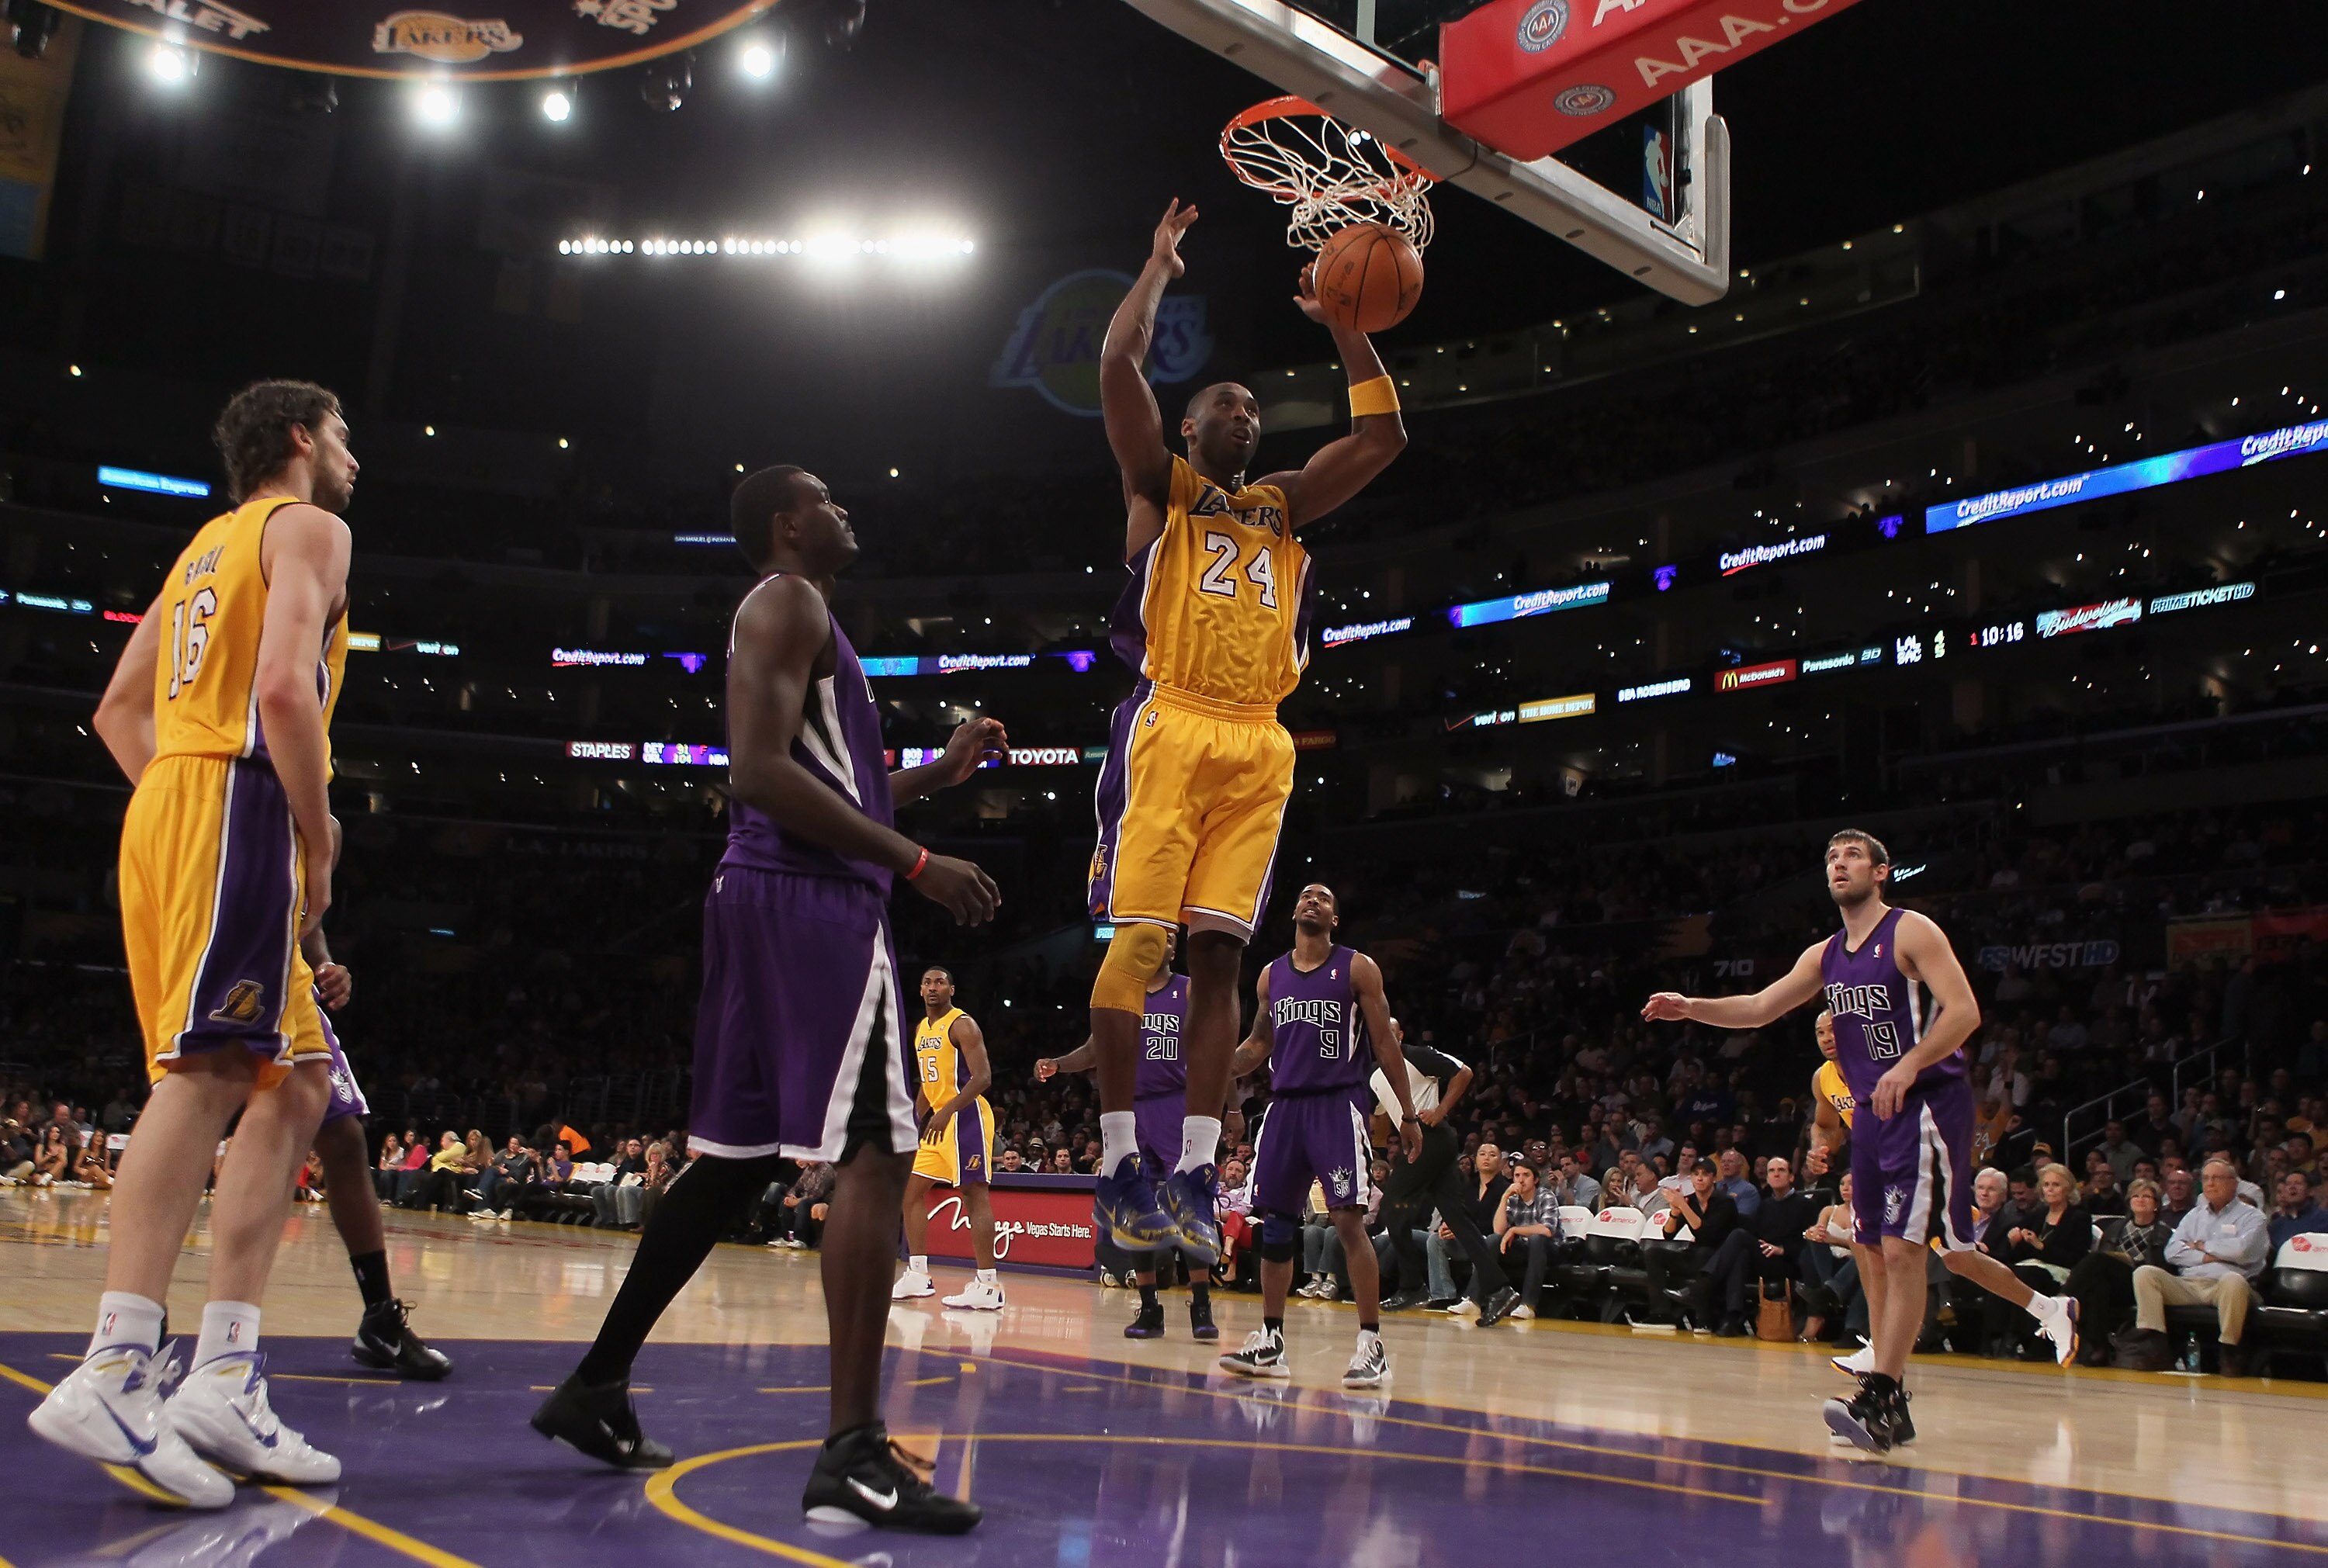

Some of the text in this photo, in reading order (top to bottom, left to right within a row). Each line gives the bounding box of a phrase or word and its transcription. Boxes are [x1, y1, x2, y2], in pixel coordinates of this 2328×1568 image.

[1531, 12, 1555, 33] AAA
[1646, 196, 1662, 216] NBA
[1007, 306, 1193, 378] LAKRS
[1956, 478, 2083, 518] CreditReport.com
[1719, 534, 1825, 570] CreditReport.com
[1199, 530, 1278, 611] 24
[1513, 582, 1610, 611] CreditReport.com
[1322, 617, 1412, 642] CreditReport.com
[2042, 597, 2129, 639] Budweiser
[168, 586, 217, 701] 16
[1896, 635, 1921, 652] LAL
[1934, 630, 1945, 645] 4
[1970, 632, 1978, 646] 1
[552, 647, 646, 666] CreditReport.com
[938, 652, 1031, 670] CreditReport.com
[1802, 652, 1855, 674] Panasonic
[1896, 649, 1922, 666] SAC
[1935, 642, 1945, 659] 5
[1739, 666, 1786, 684] McDonald's
[1520, 700, 1594, 719] THE HOME DEPOT
[570, 742, 632, 760] STAPLES
[643, 742, 665, 754] DET
[676, 742, 689, 755] 91
[643, 753, 663, 763] ORL
[708, 753, 729, 766] NBA
[1009, 749, 1079, 766] TOYOTA
[1096, 927, 1115, 939] PRI
[1713, 958, 1755, 978] 710
[1274, 995, 1341, 1029] Kings
[1824, 981, 1892, 1021] Kings
[916, 1036, 943, 1052] LAKERS
[1146, 1037, 1179, 1061] 20
[1320, 1030, 1339, 1059] 9
[1861, 1021, 1901, 1061] 19
[918, 1056, 940, 1082] 15
[1974, 1131, 1990, 1147] 24
[927, 1196, 1092, 1260] Mage Vegas Starts Here.
